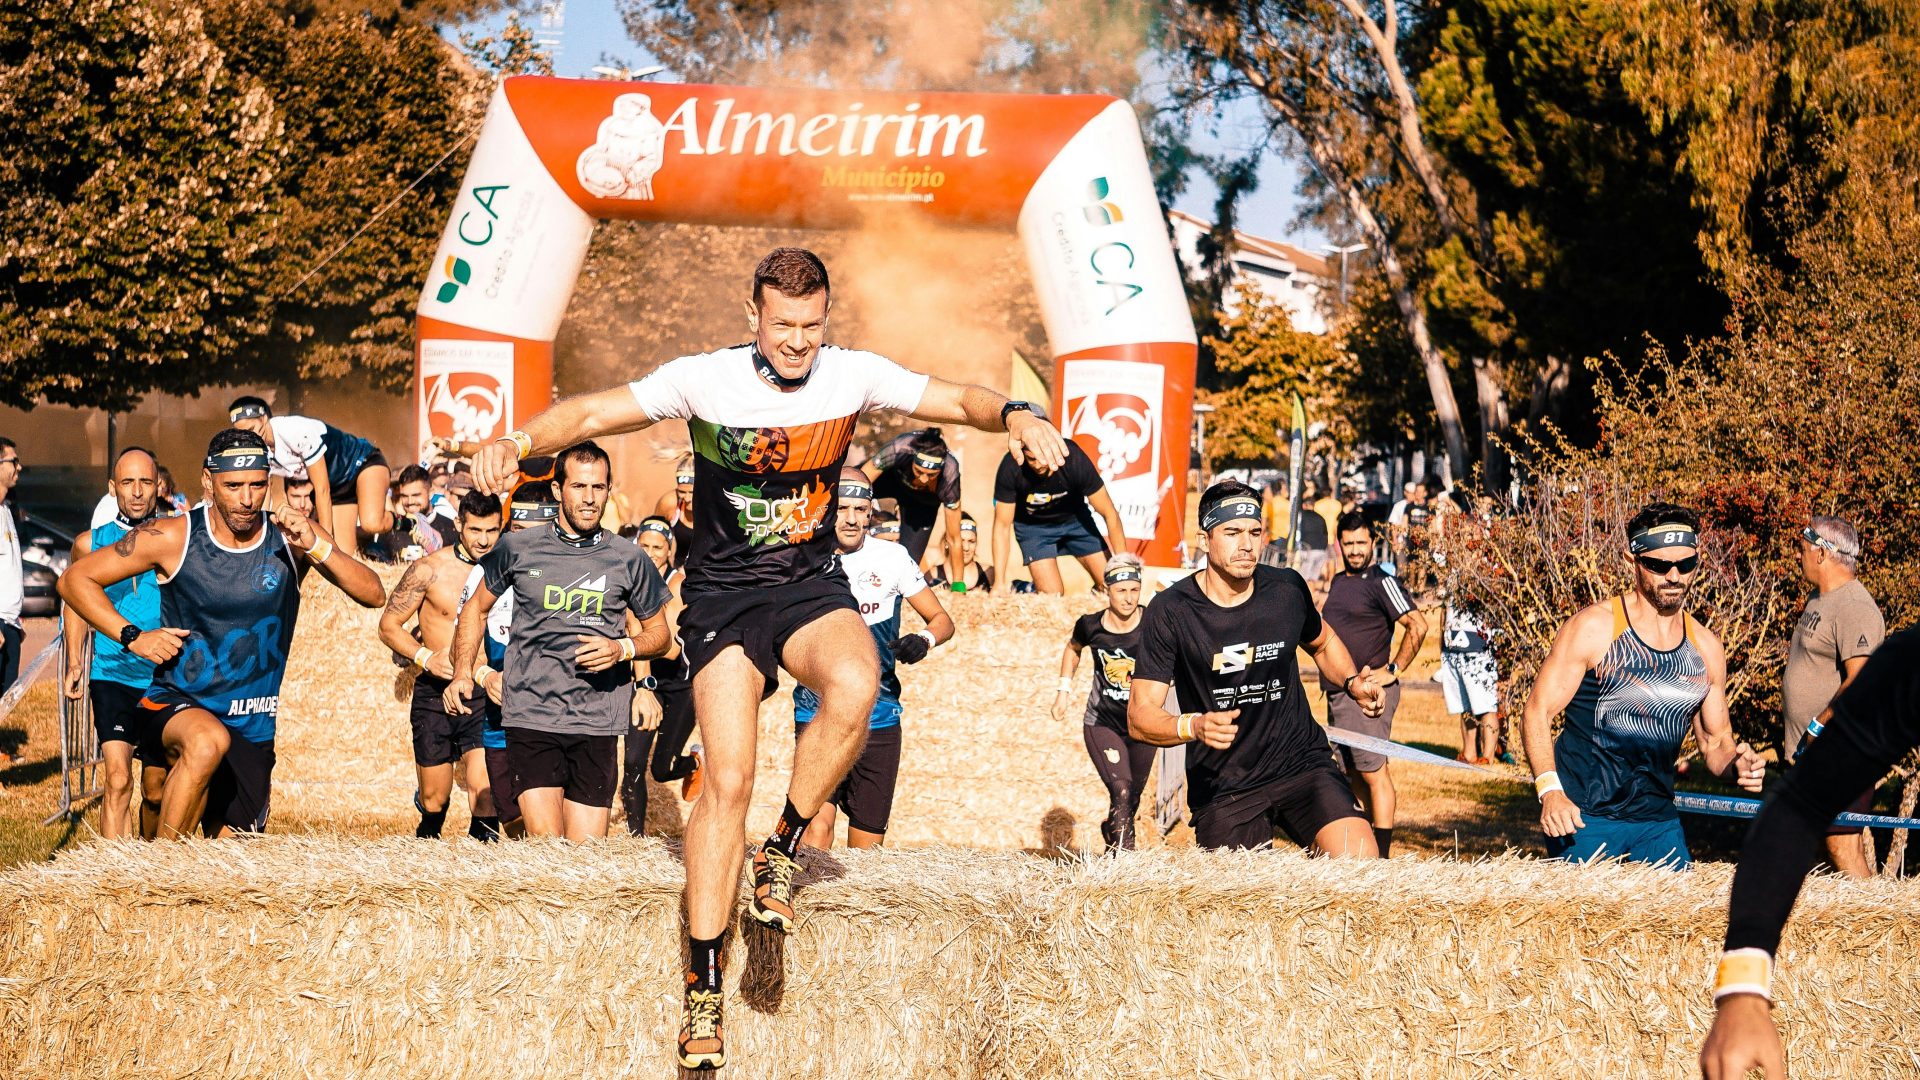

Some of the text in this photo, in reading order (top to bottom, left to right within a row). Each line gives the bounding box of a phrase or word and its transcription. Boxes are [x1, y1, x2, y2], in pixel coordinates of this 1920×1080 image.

[663, 97, 988, 157] Almeirim
[821, 165, 945, 193] Município
[459, 185, 511, 246] CA
[1090, 241, 1143, 316] CA
[233, 455, 257, 468] 87
[845, 486, 861, 496] 71
[513, 509, 529, 519] 72
[745, 497, 809, 522] OCR
[1235, 503, 1256, 516] 93
[1663, 532, 1685, 544] 81
[1256, 641, 1285, 652] STONE
[173, 615, 285, 692] OCR
[1255, 649, 1279, 659] RACE
